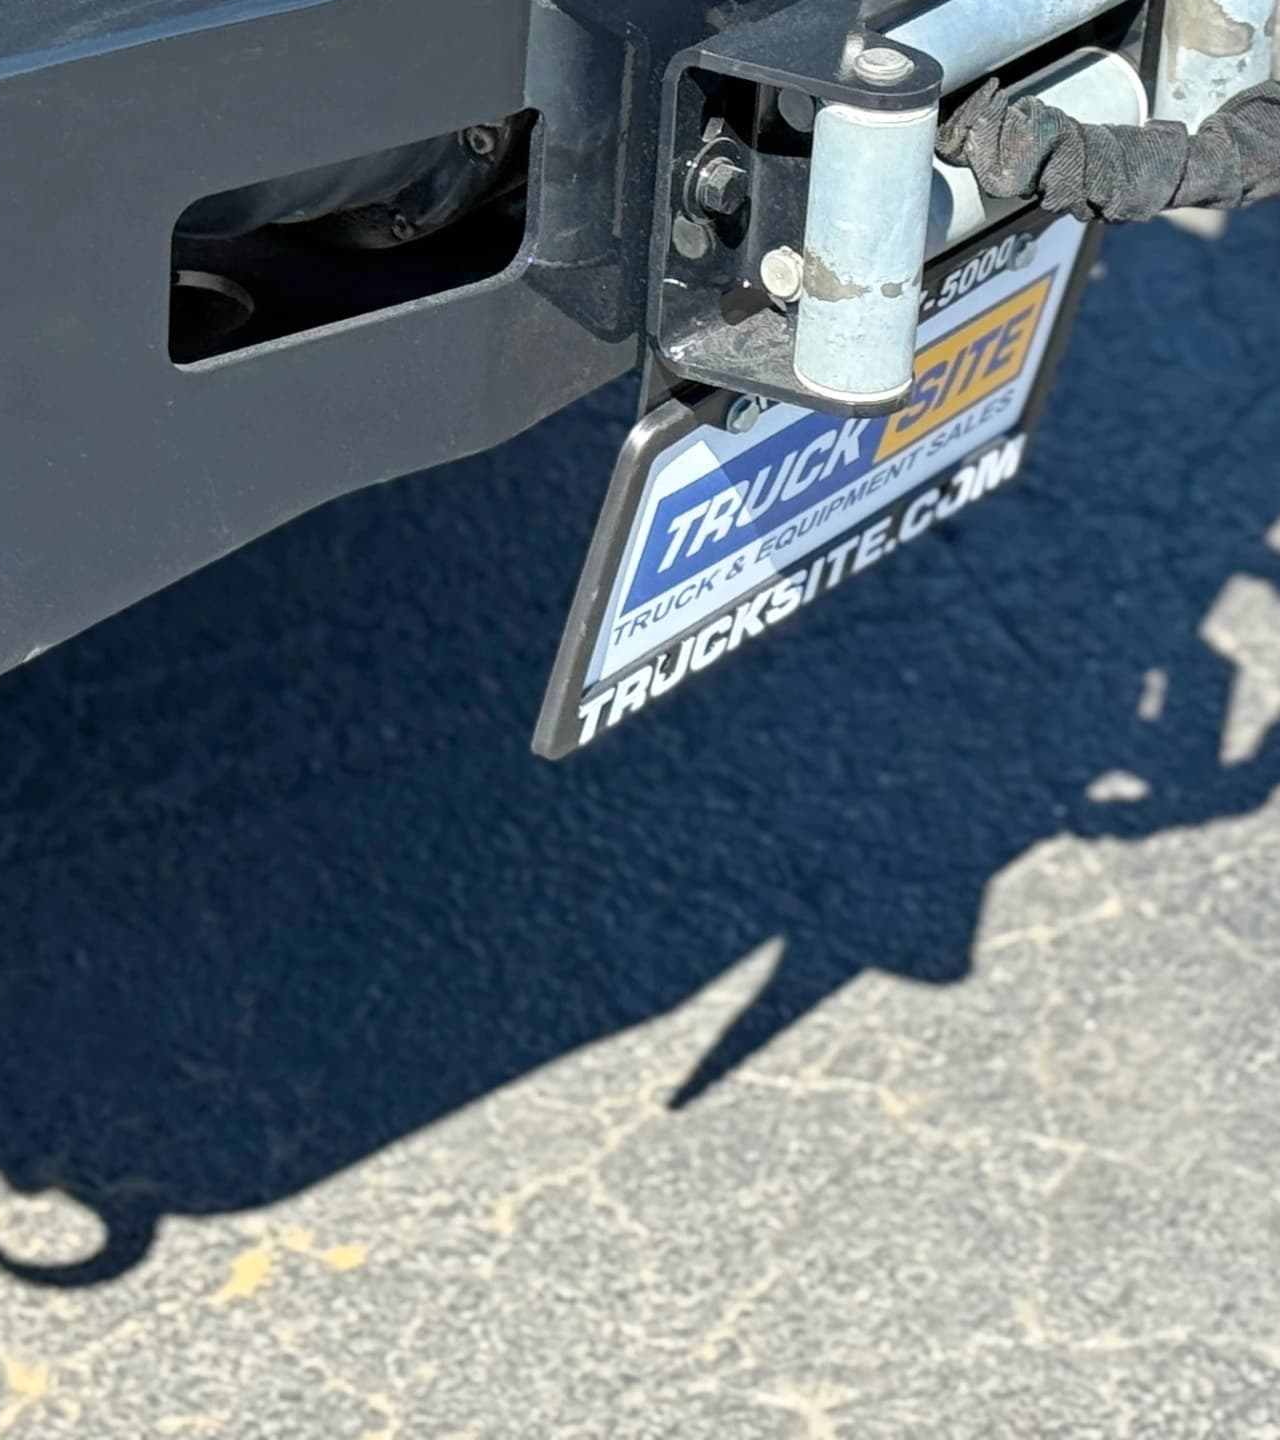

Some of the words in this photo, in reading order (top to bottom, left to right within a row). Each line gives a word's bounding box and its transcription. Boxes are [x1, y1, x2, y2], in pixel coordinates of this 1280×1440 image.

[613, 569, 728, 647] TRUCK
[724, 554, 747, 581] &
[754, 444, 928, 565] EQUIPMENT
[926, 388, 1015, 457] SALES
[657, 418, 871, 573] TRUCK
[895, 306, 1035, 434] SITE
[578, 432, 1027, 746] TRUCKSITE.COM
